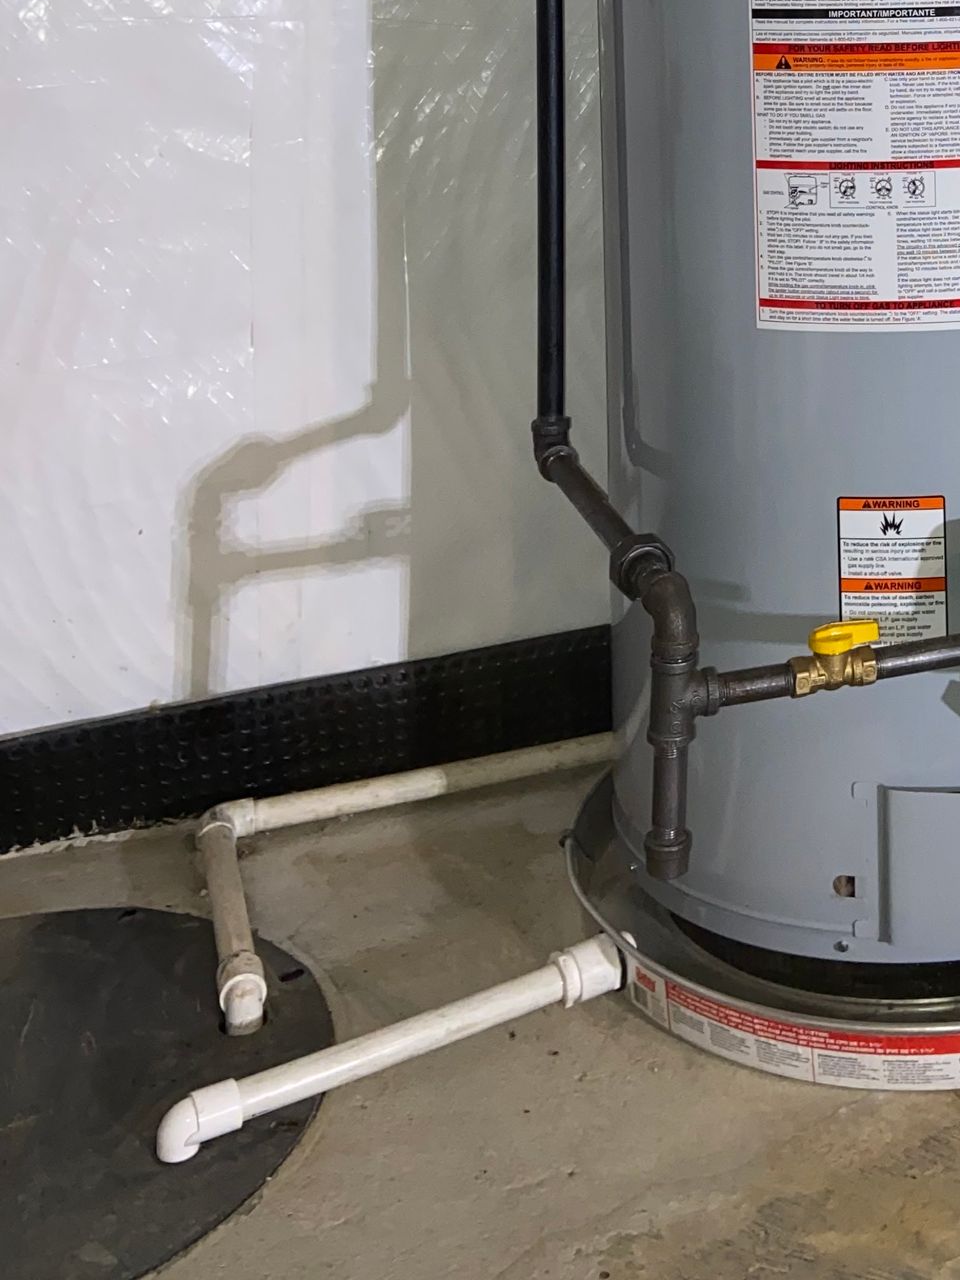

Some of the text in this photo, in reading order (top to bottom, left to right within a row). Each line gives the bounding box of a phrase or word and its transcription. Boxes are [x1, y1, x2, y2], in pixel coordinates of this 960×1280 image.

[828, 9, 936, 18] IMPORTANT/IMPORTANTE
[789, 44, 806, 52] FOR
[808, 44, 831, 52] YOUR
[833, 44, 866, 52] SAFETY
[868, 43, 892, 52] READ
[895, 43, 929, 51] BEFORE
[829, 161, 934, 170] LIGHTING INSTRUCTIONS
[893, 301, 904, 309] TO
[872, 500, 920, 508] WARNING
[874, 582, 922, 590] WARNING
